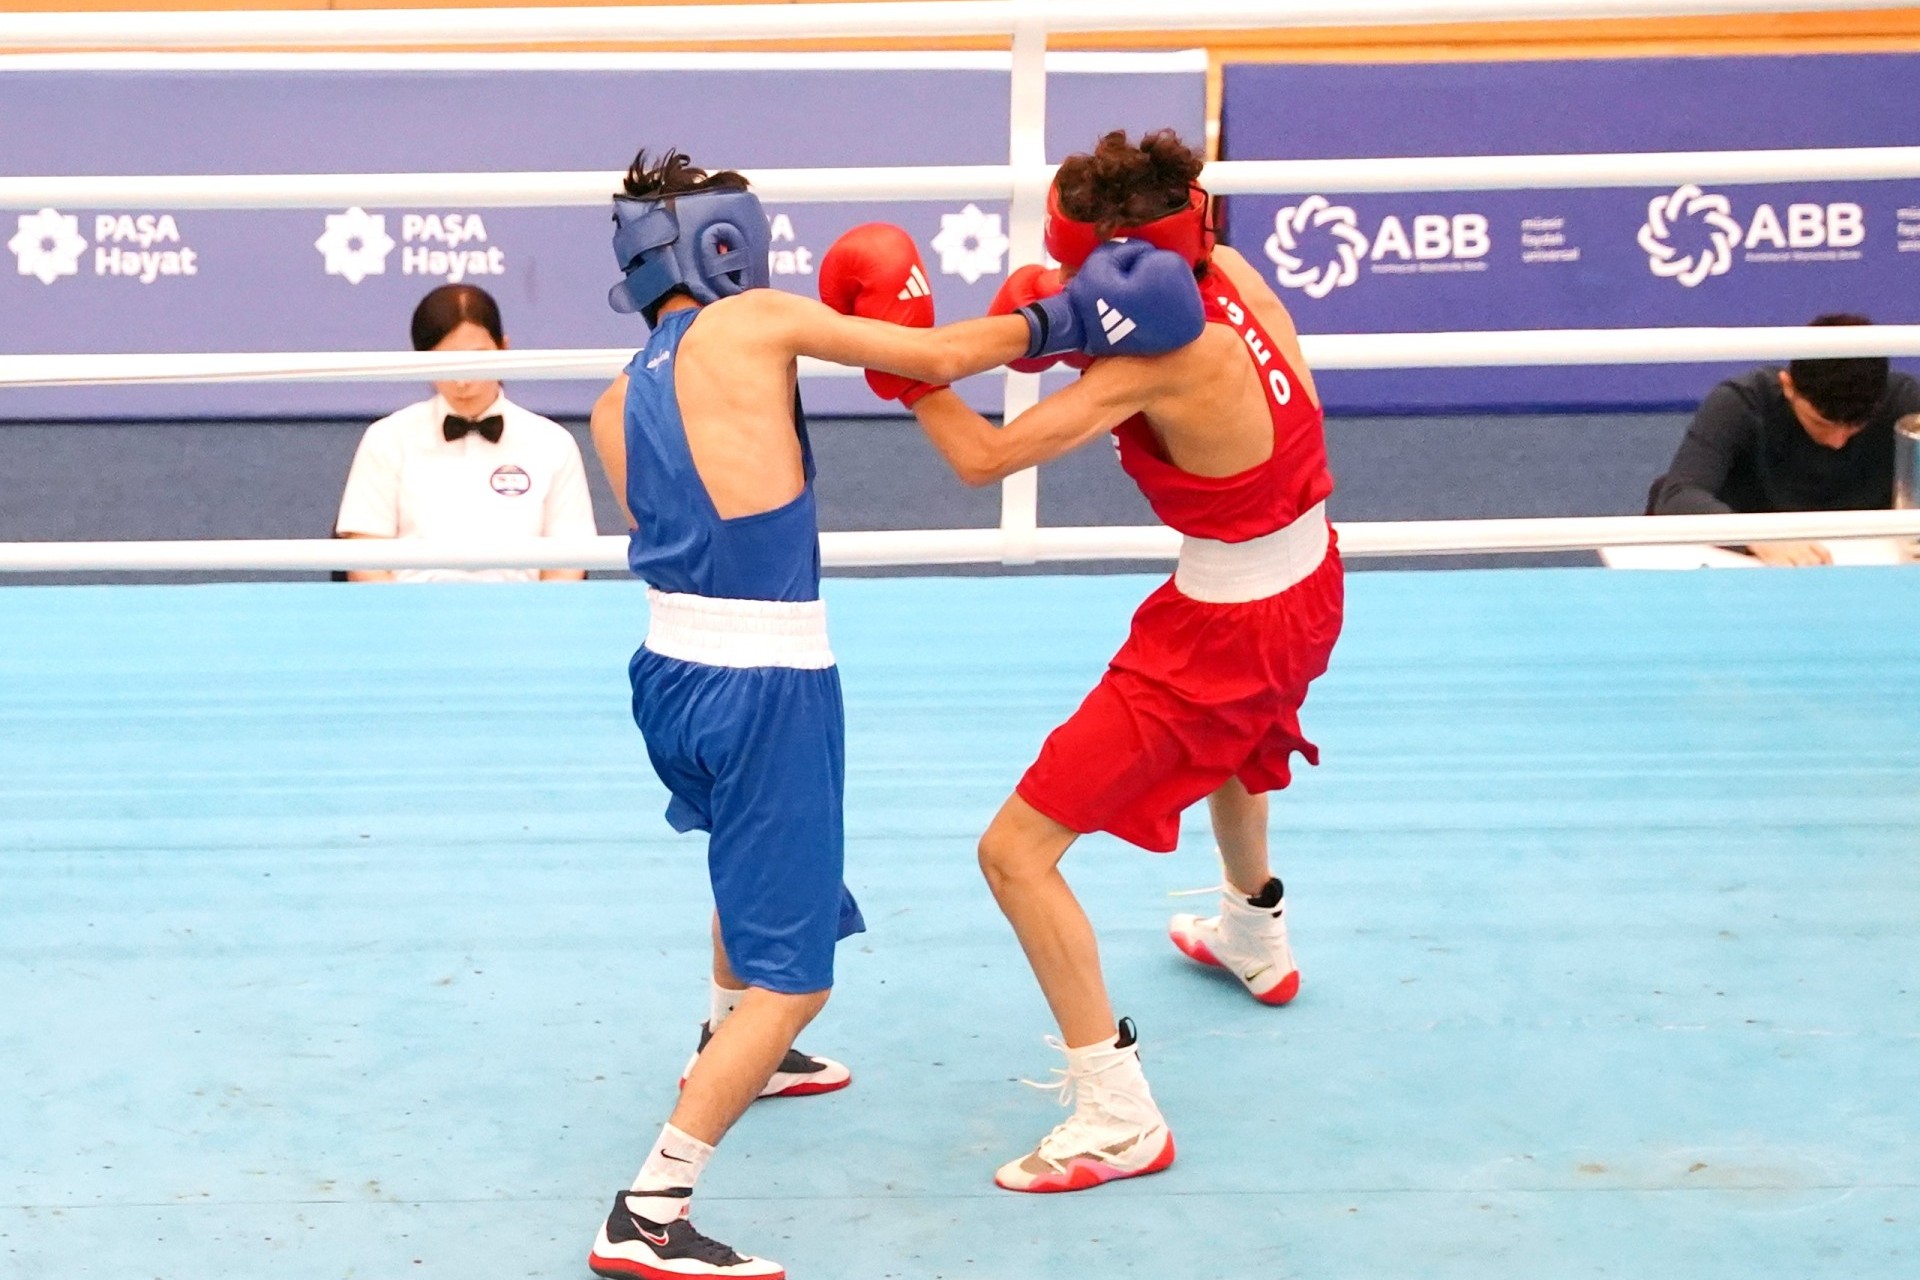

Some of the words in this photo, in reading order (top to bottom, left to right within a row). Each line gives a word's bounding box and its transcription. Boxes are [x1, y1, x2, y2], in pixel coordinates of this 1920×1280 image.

[95, 214, 180, 248] PAŞA
[402, 213, 487, 248] PAŞA
[1371, 214, 1491, 260] ABB
[1745, 203, 1865, 248] ABB
